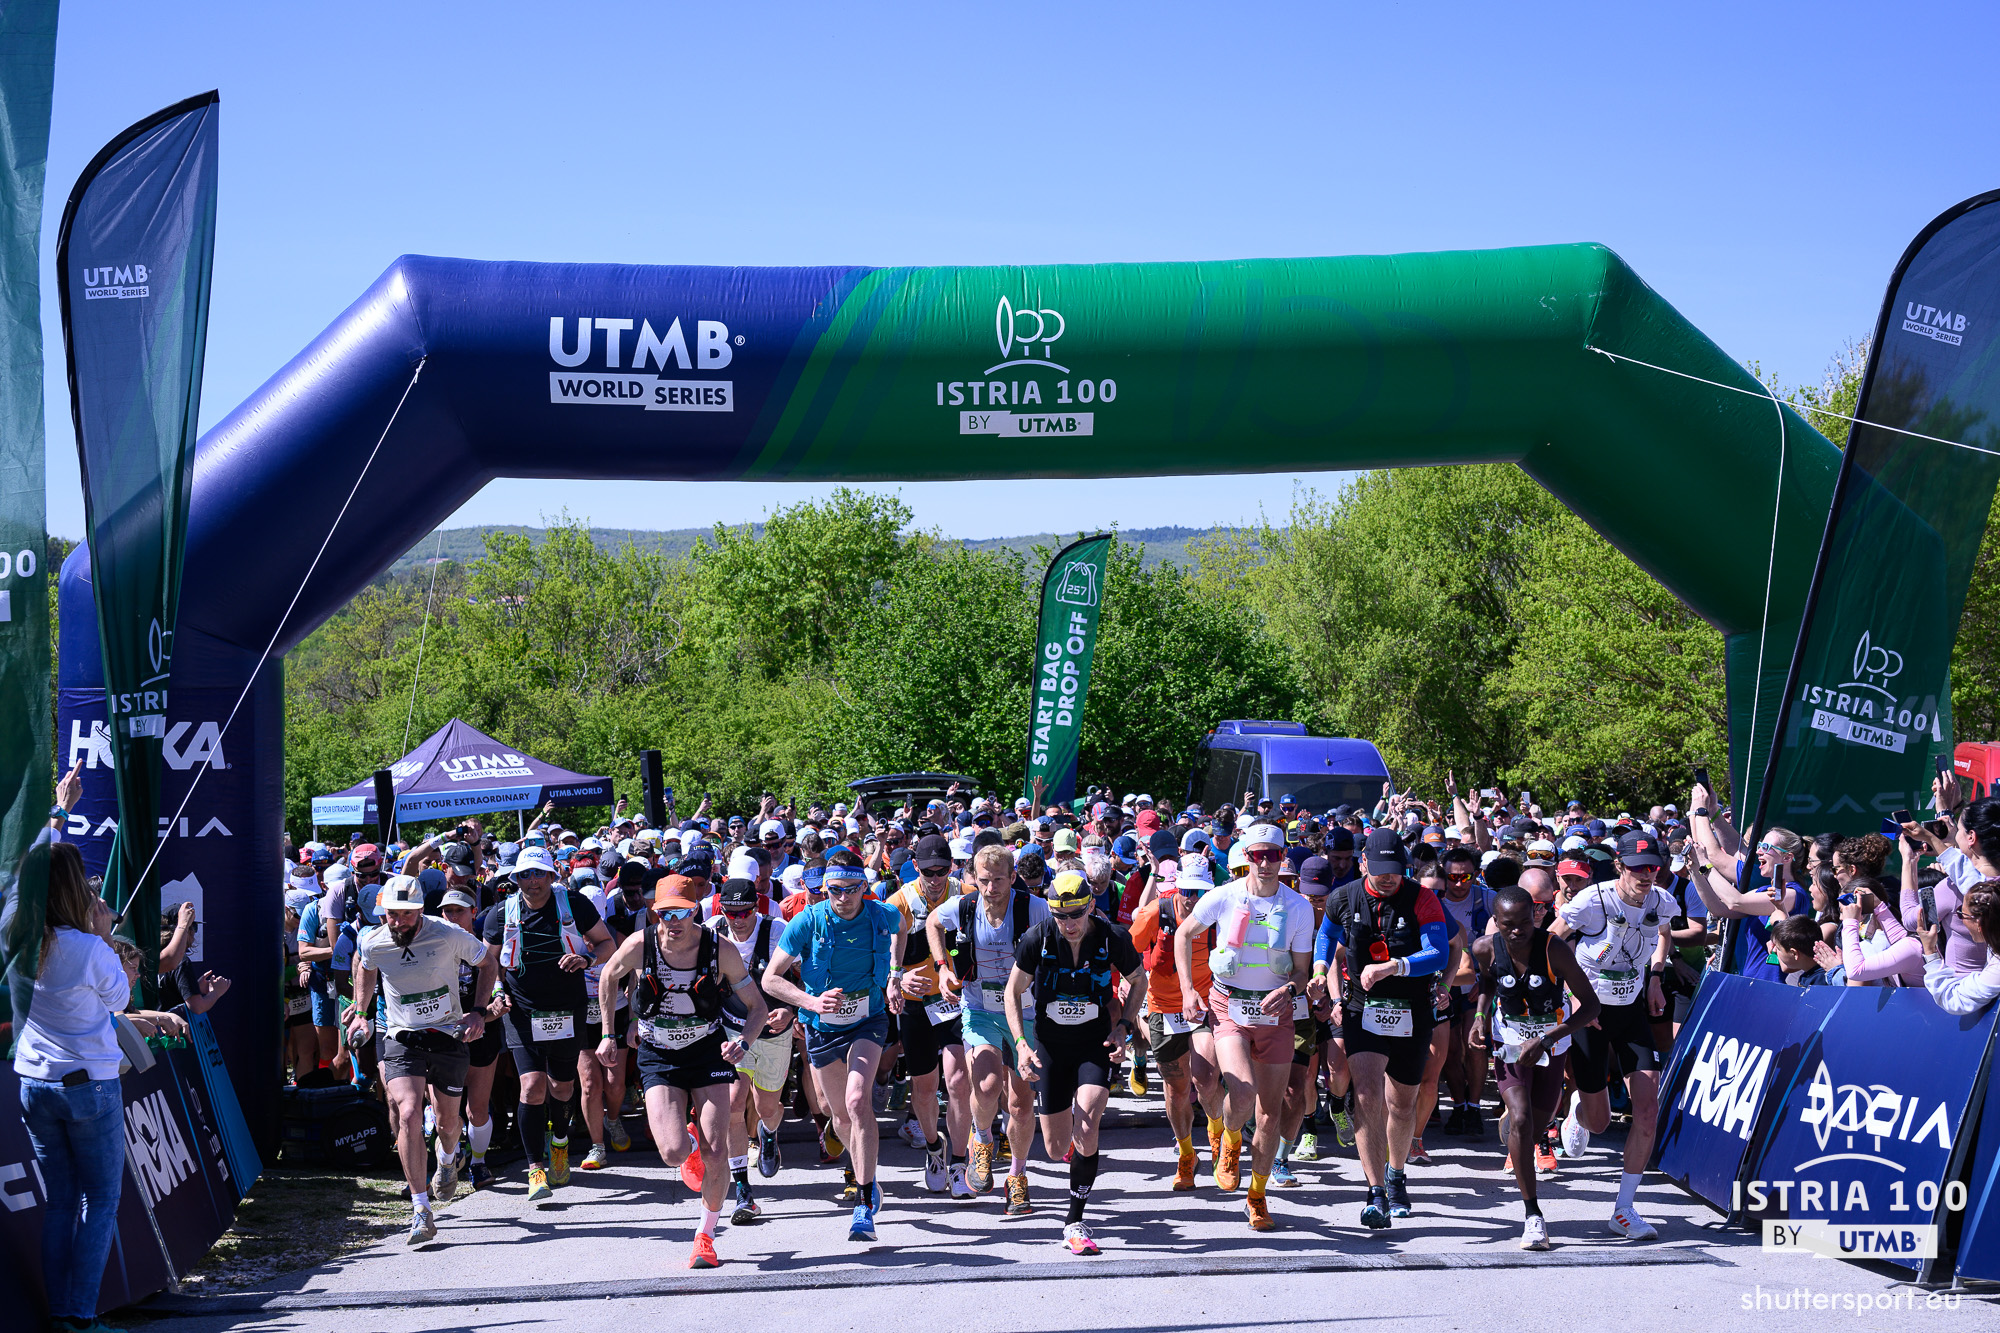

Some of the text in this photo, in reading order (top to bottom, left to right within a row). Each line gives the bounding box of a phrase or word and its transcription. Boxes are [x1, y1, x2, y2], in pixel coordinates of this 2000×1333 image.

[84, 264, 148, 286] UTMB
[88, 288, 147, 297] WORLD SERIES
[1906, 301, 1966, 332] UTMB
[1905, 322, 1960, 344] WORLD SERIES
[558, 379, 726, 405] WORLD SERIES
[937, 379, 1117, 405] ISTRIA 100
[969, 415, 1078, 434] BY UTMB
[1066, 584, 1087, 596] 257
[1056, 611, 1088, 727] DROP OFF
[1032, 642, 1063, 767] START BAG
[1802, 683, 1928, 731] ISTRIA 100
[1817, 713, 1898, 747] BY UTMB
[438, 753, 525, 773] UTMB
[454, 767, 529, 780] WORLD SERIES
[549, 786, 603, 798] UTMB.WORLD
[400, 793, 530, 812] MEET YOUR EXTRAORDINARY
[1612, 985, 1635, 995] 3012
[416, 1003, 440, 1016] 3019
[835, 1005, 858, 1015] 007
[1058, 1007, 1086, 1015] 3025
[541, 1022, 563, 1031] 3672
[1375, 1014, 1402, 1025] 3607
[667, 1032, 697, 1041] 3005
[1678, 1031, 1773, 1142] HOKA
[1800, 1083, 1952, 1150] DACIA
[335, 1126, 377, 1147] MYLAPS
